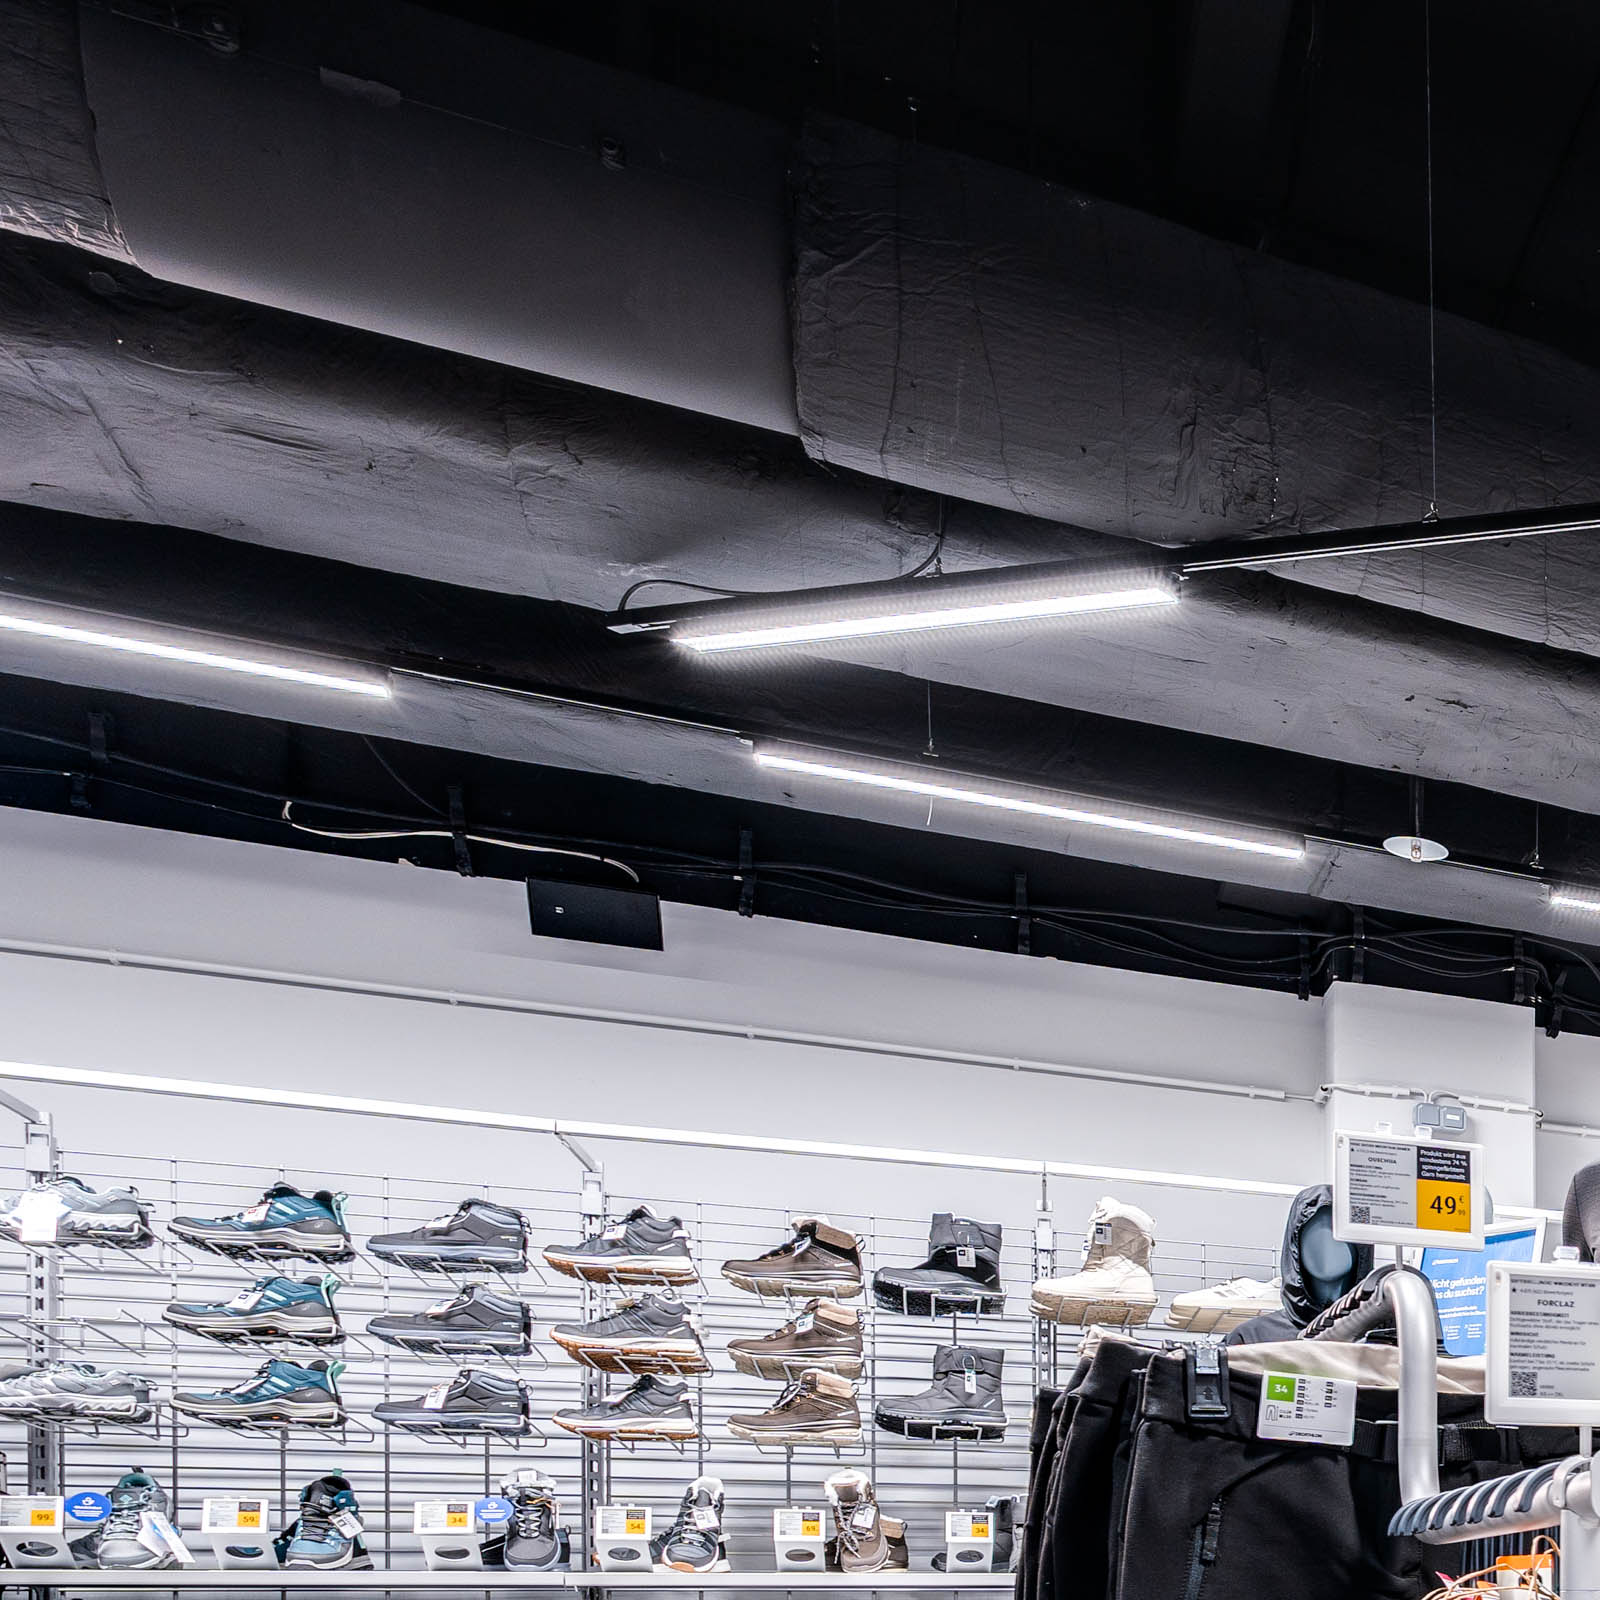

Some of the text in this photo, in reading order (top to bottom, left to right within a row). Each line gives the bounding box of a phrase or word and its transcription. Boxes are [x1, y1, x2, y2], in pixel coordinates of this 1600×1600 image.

[1420, 1157, 1451, 1165] mindestens
[1422, 1164, 1465, 1173] spinngefärbtem
[1436, 1172, 1466, 1180] hergestellt
[1430, 1196, 1456, 1214] 49
[1455, 1286, 1485, 1296] suchst?
[1537, 1299, 1574, 1308] FORCLAZ
[1274, 1384, 1288, 1393] 34
